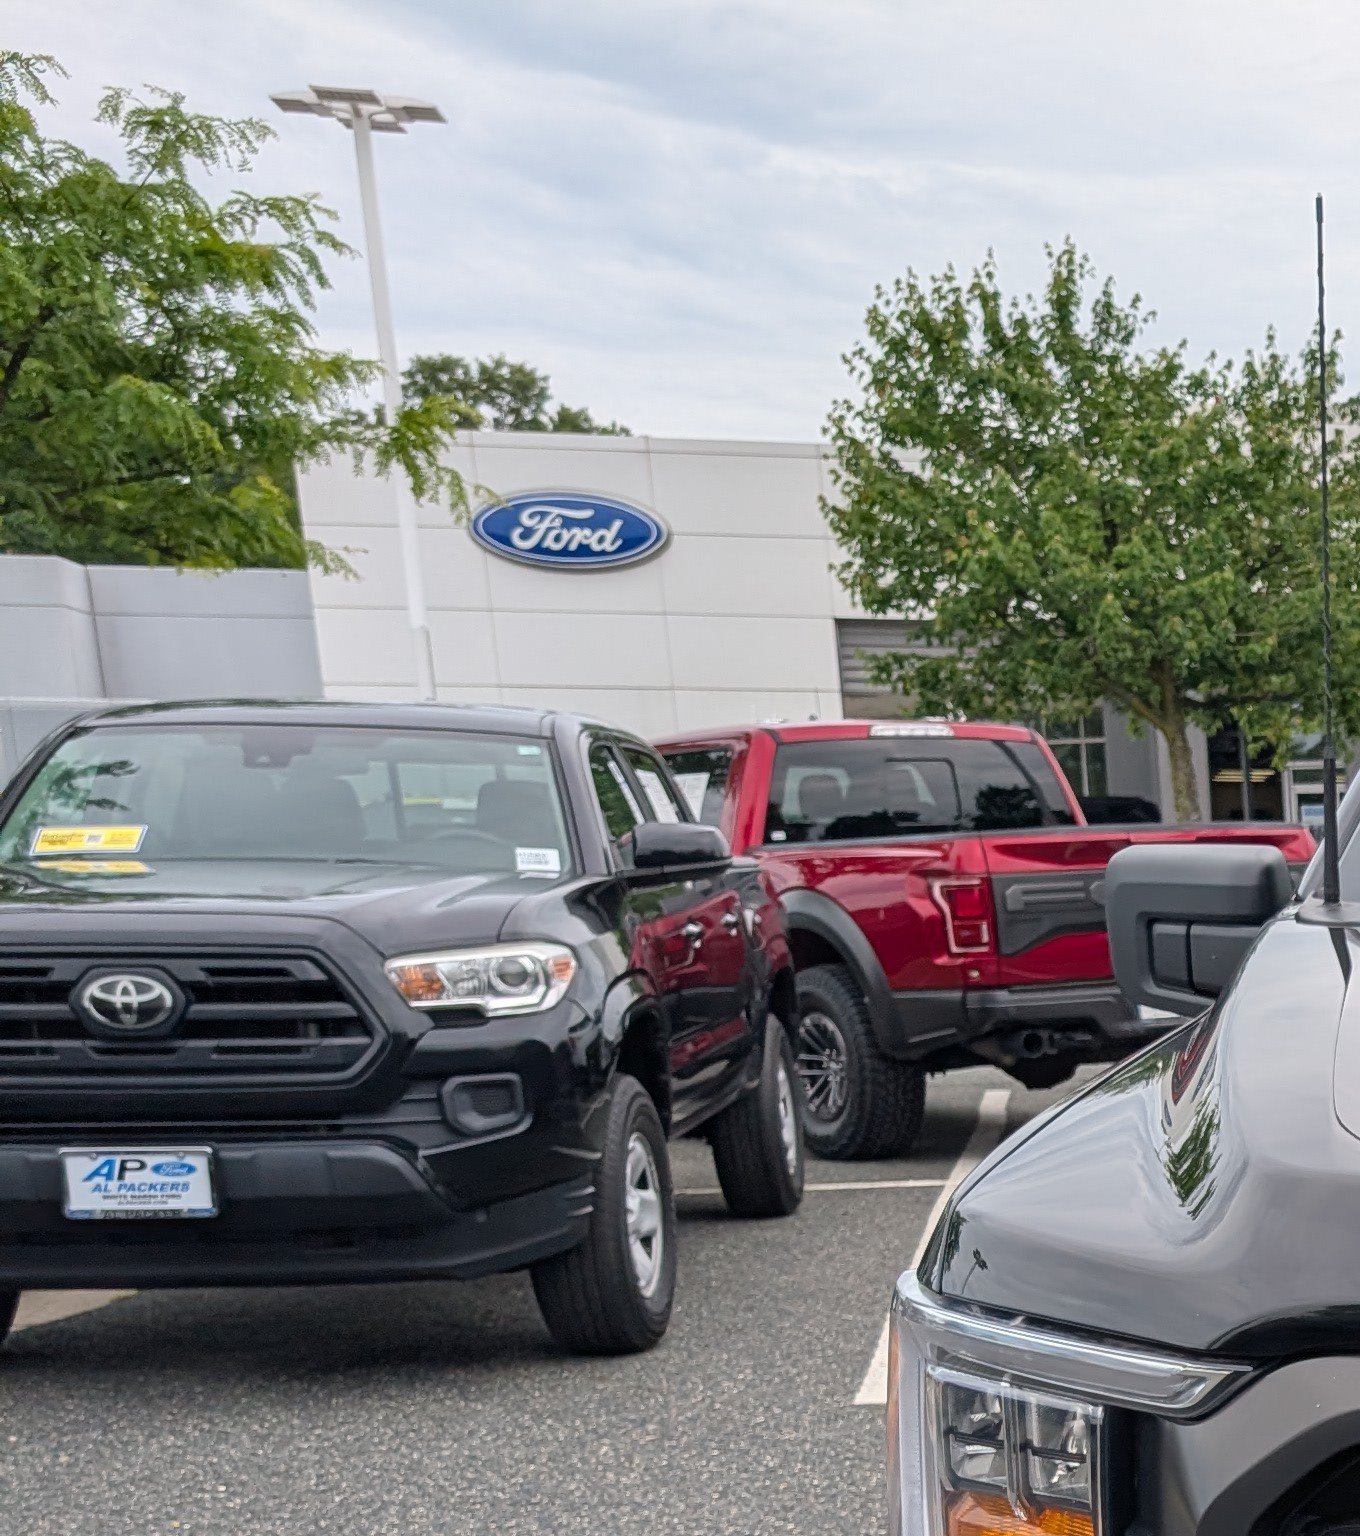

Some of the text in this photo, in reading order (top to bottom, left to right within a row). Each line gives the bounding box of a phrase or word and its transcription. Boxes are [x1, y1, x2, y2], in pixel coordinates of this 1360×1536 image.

[511, 505, 624, 552] Ford
[82, 1156, 147, 1183] AP
[92, 1181, 191, 1194] AL PACKERS
